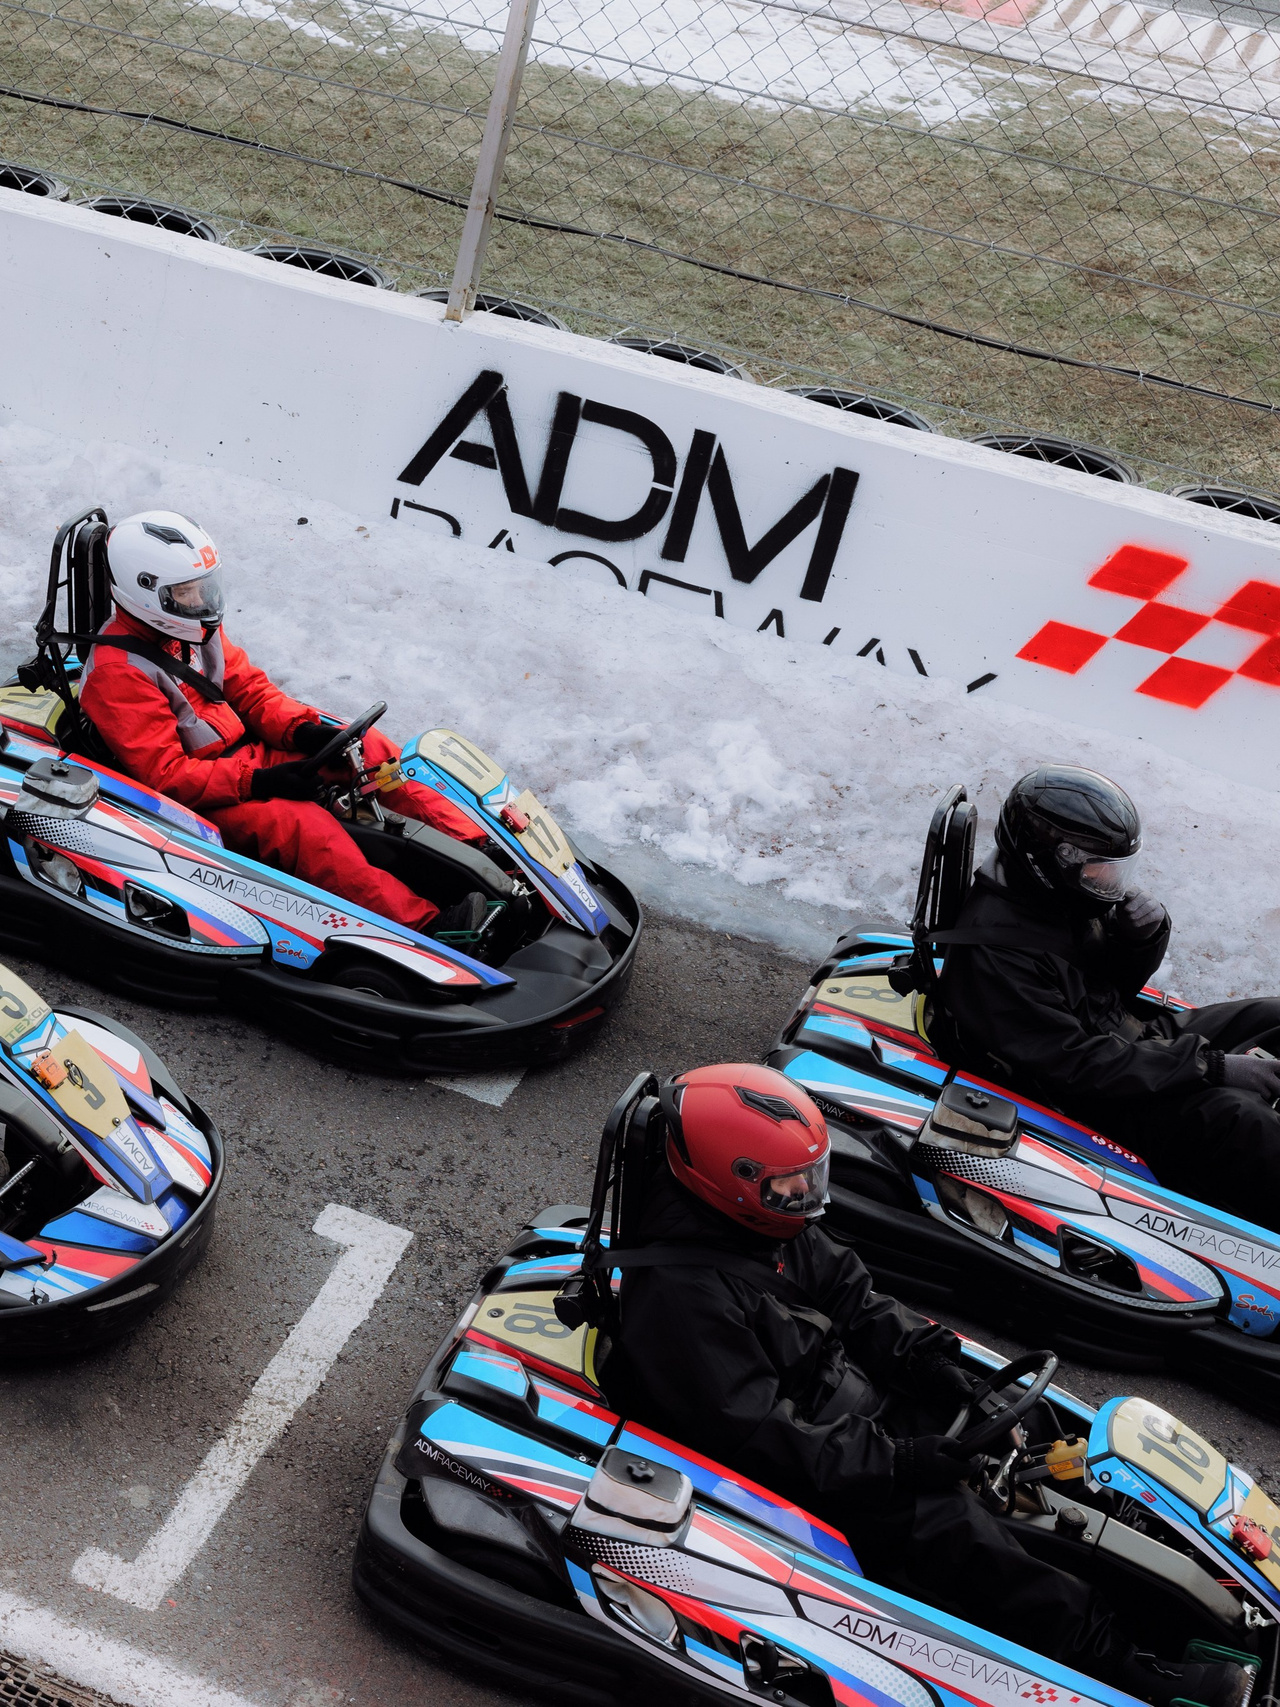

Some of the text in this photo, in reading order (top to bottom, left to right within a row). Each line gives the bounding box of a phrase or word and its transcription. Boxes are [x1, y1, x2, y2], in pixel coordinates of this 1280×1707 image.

[396, 369, 861, 603] ADM
[438, 736, 491, 780] 17
[527, 815, 560, 859] 17
[190, 867, 328, 923] ADMRACEWAY
[844, 986, 903, 1003] 8
[116, 1126, 153, 1171] ADMR
[504, 1303, 573, 1339] 18
[414, 1439, 490, 1490] ADMRACEWAY
[833, 1614, 1031, 1694] ADMRACEWAY
